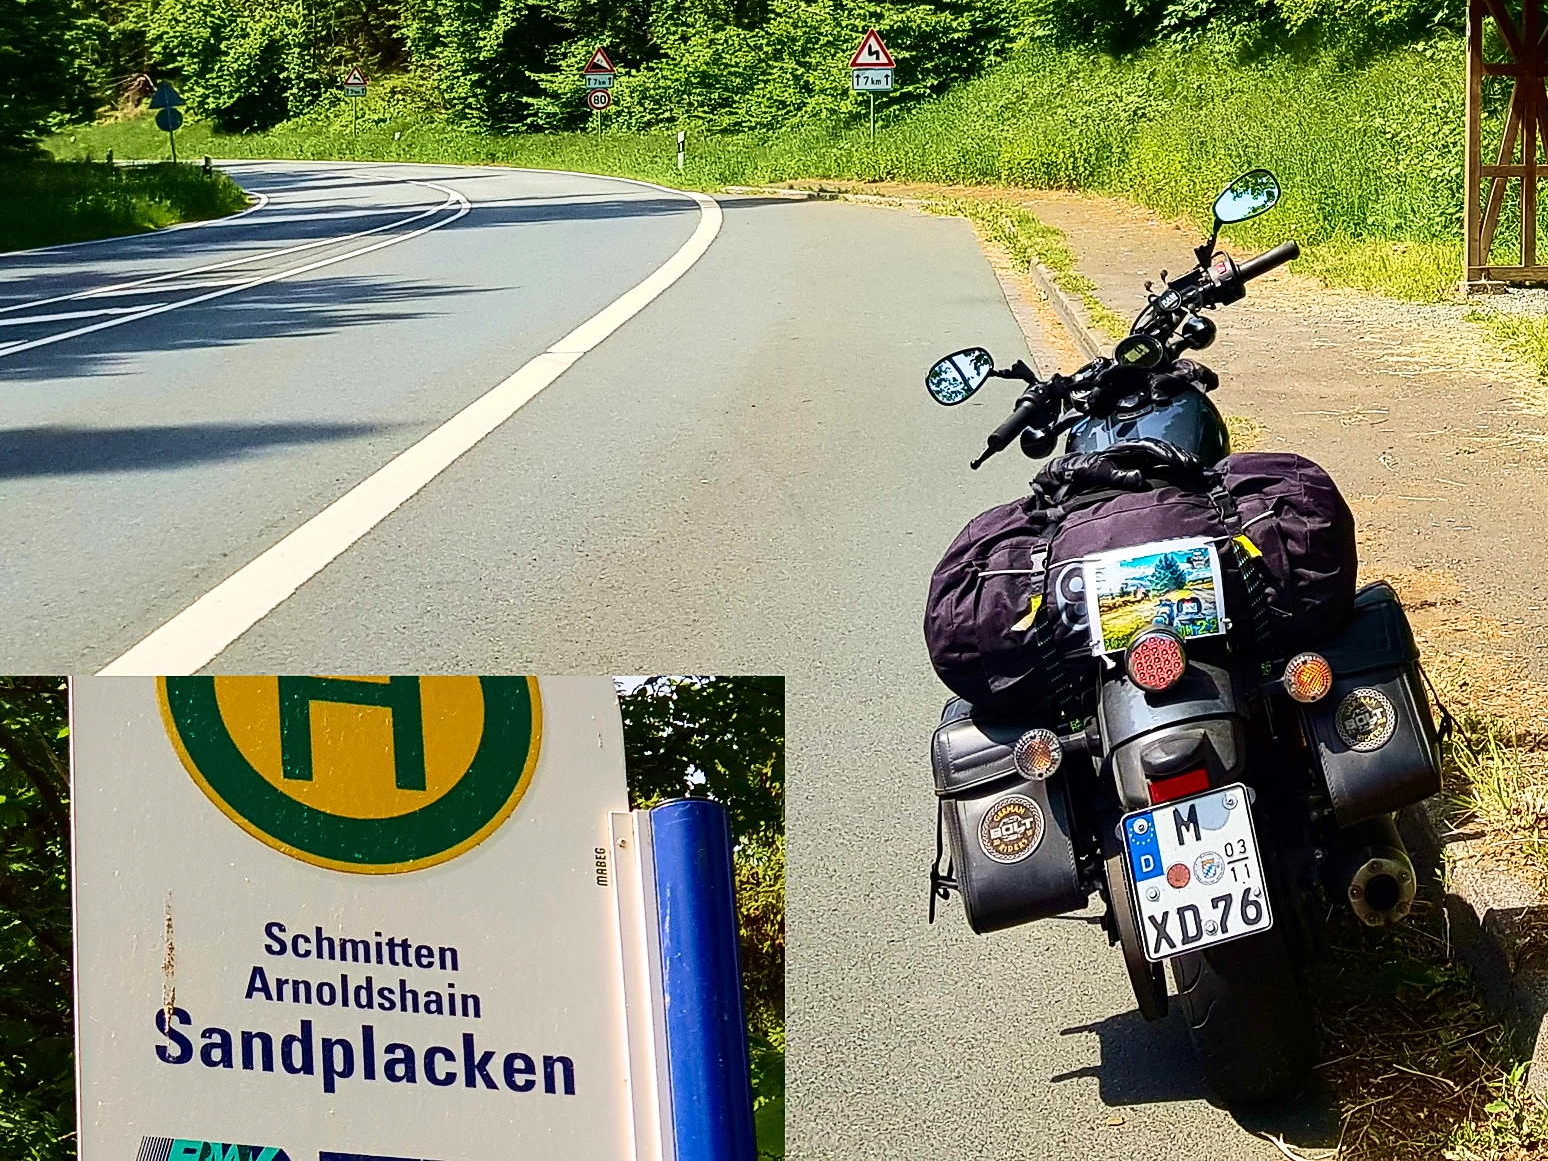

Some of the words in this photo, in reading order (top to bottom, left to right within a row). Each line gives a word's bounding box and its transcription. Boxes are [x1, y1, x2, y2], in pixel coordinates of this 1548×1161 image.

[863, 76, 870, 86] 7
[871, 77, 881, 86] km
[593, 95, 607, 104] 80
[993, 804, 1026, 821] GERMAN
[990, 818, 1034, 839] BOLT
[1173, 804, 1201, 846] M
[999, 839, 1028, 853] RIDERS
[1224, 839, 1247, 857] 03
[594, 847, 608, 886] MABEG
[1140, 855, 1155, 873] D
[1230, 863, 1251, 882] 11
[1148, 904, 1203, 954] XD
[1211, 887, 1263, 934] 76
[263, 921, 460, 971] Schmitten
[244, 965, 482, 1019] Arnoldshain
[154, 1006, 577, 1096] Sandplacken
